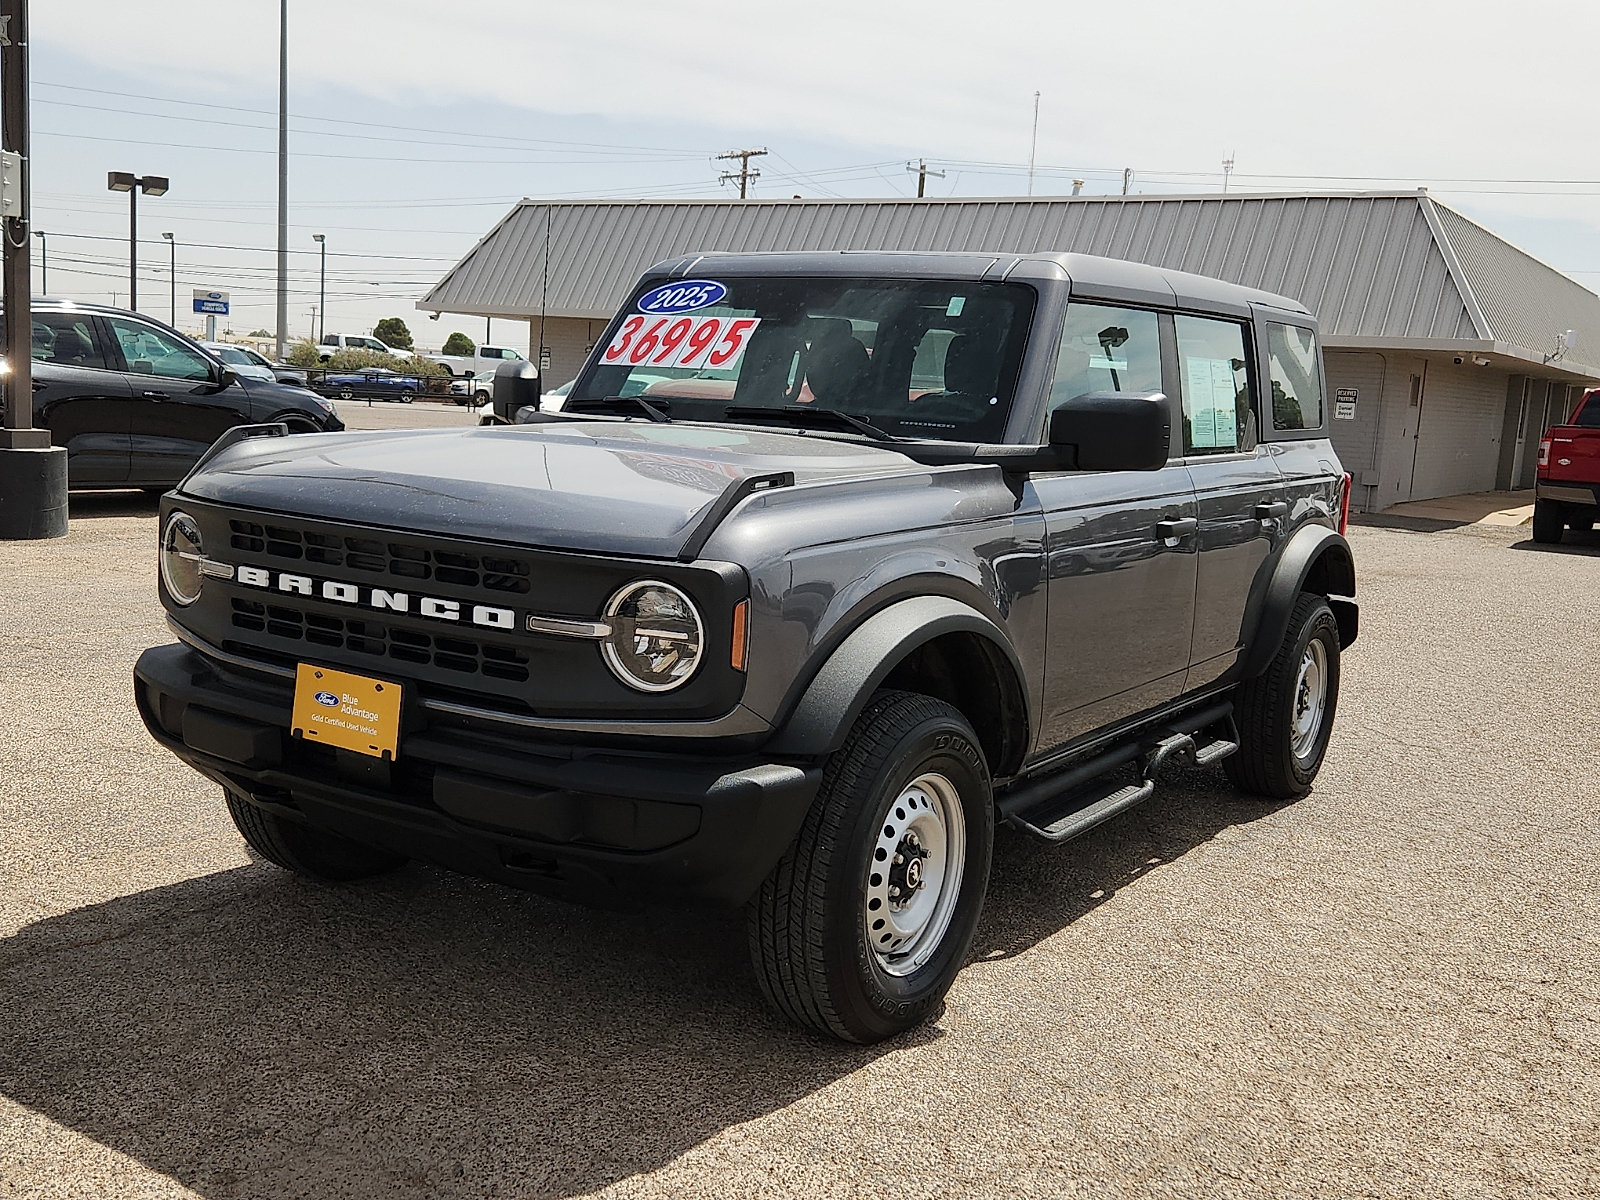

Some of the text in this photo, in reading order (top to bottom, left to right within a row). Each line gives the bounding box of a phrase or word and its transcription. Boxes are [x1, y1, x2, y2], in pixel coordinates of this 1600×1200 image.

[647, 285, 716, 310] 2025
[605, 316, 756, 366] 36995
[237, 565, 515, 630] BRONCO
[318, 692, 336, 706] Ford
[342, 693, 358, 706] Blue
[340, 704, 379, 722] Advantage
[311, 714, 378, 736] Gold Certified Used Vehicle
